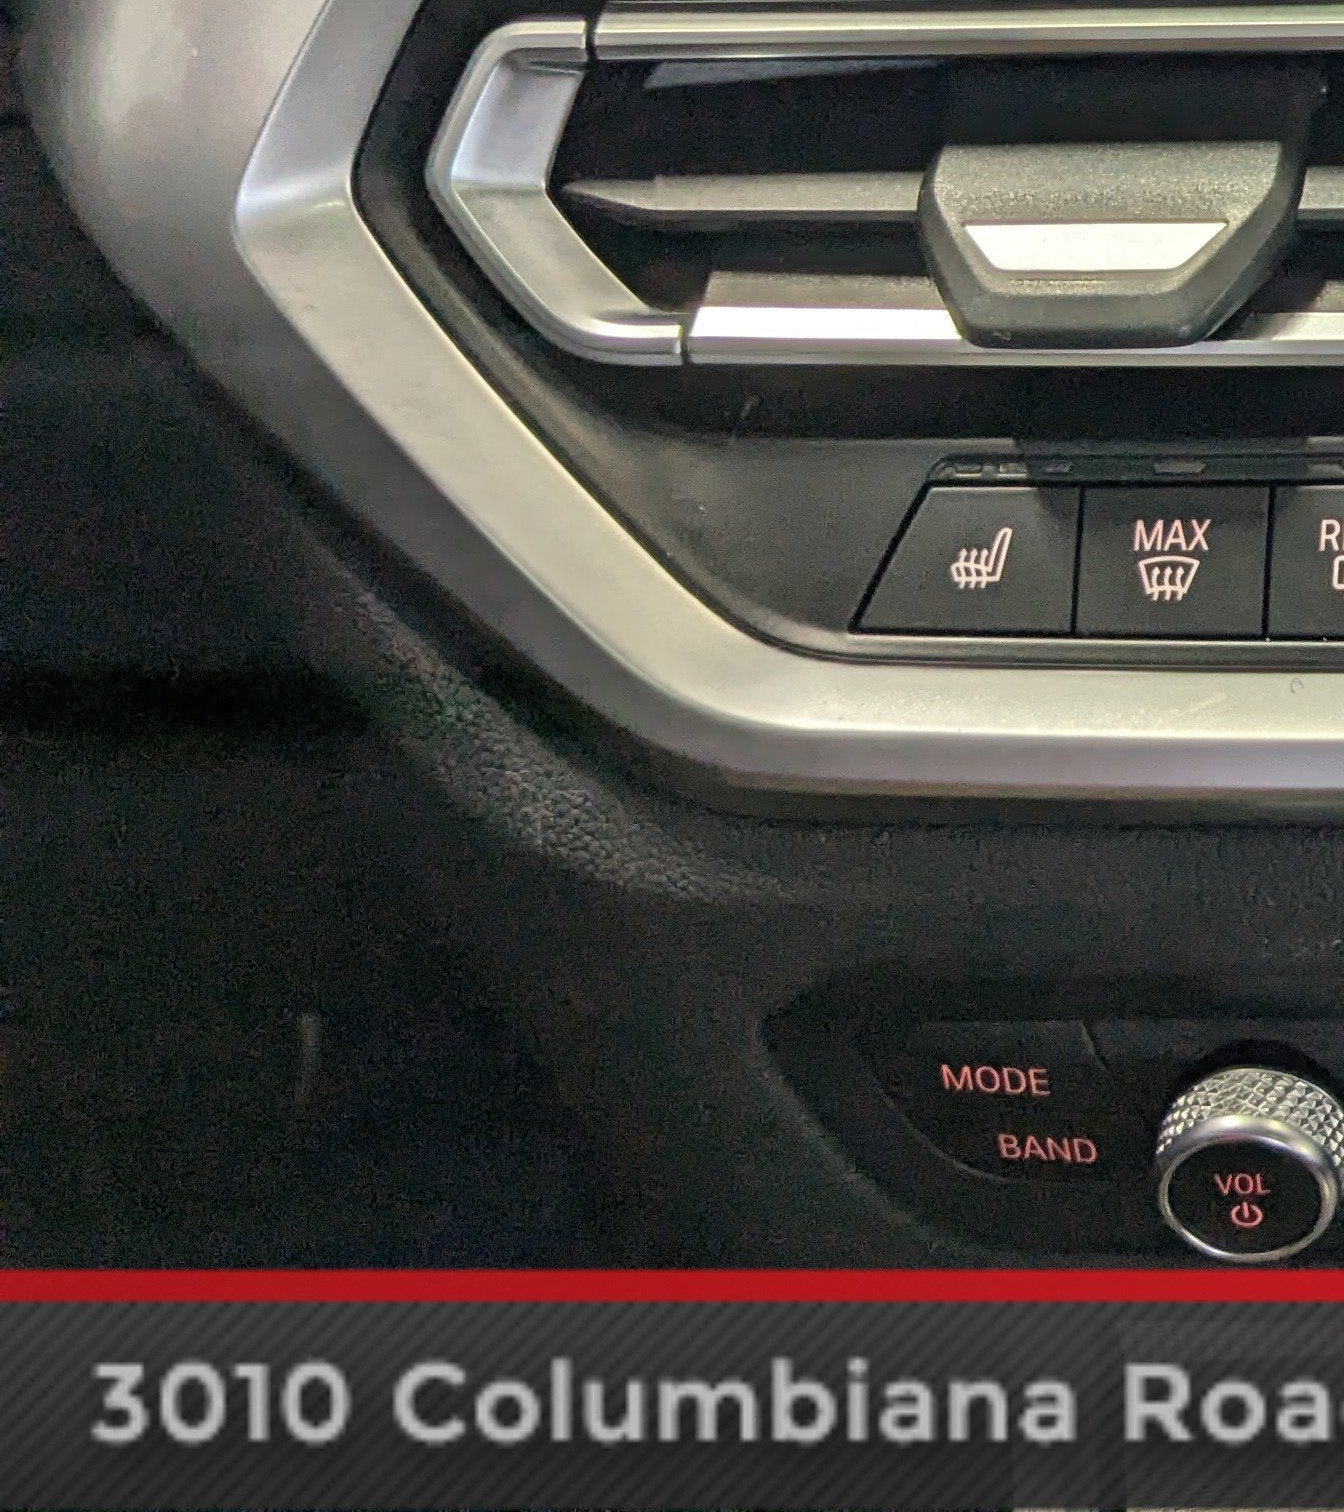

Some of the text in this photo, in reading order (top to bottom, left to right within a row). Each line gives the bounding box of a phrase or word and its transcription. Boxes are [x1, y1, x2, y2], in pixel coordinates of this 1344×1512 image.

[1131, 518, 1211, 553] MAX
[941, 1063, 1051, 1098] MODE
[998, 1132, 1098, 1166] BAND
[1213, 1172, 1270, 1197] VOL
